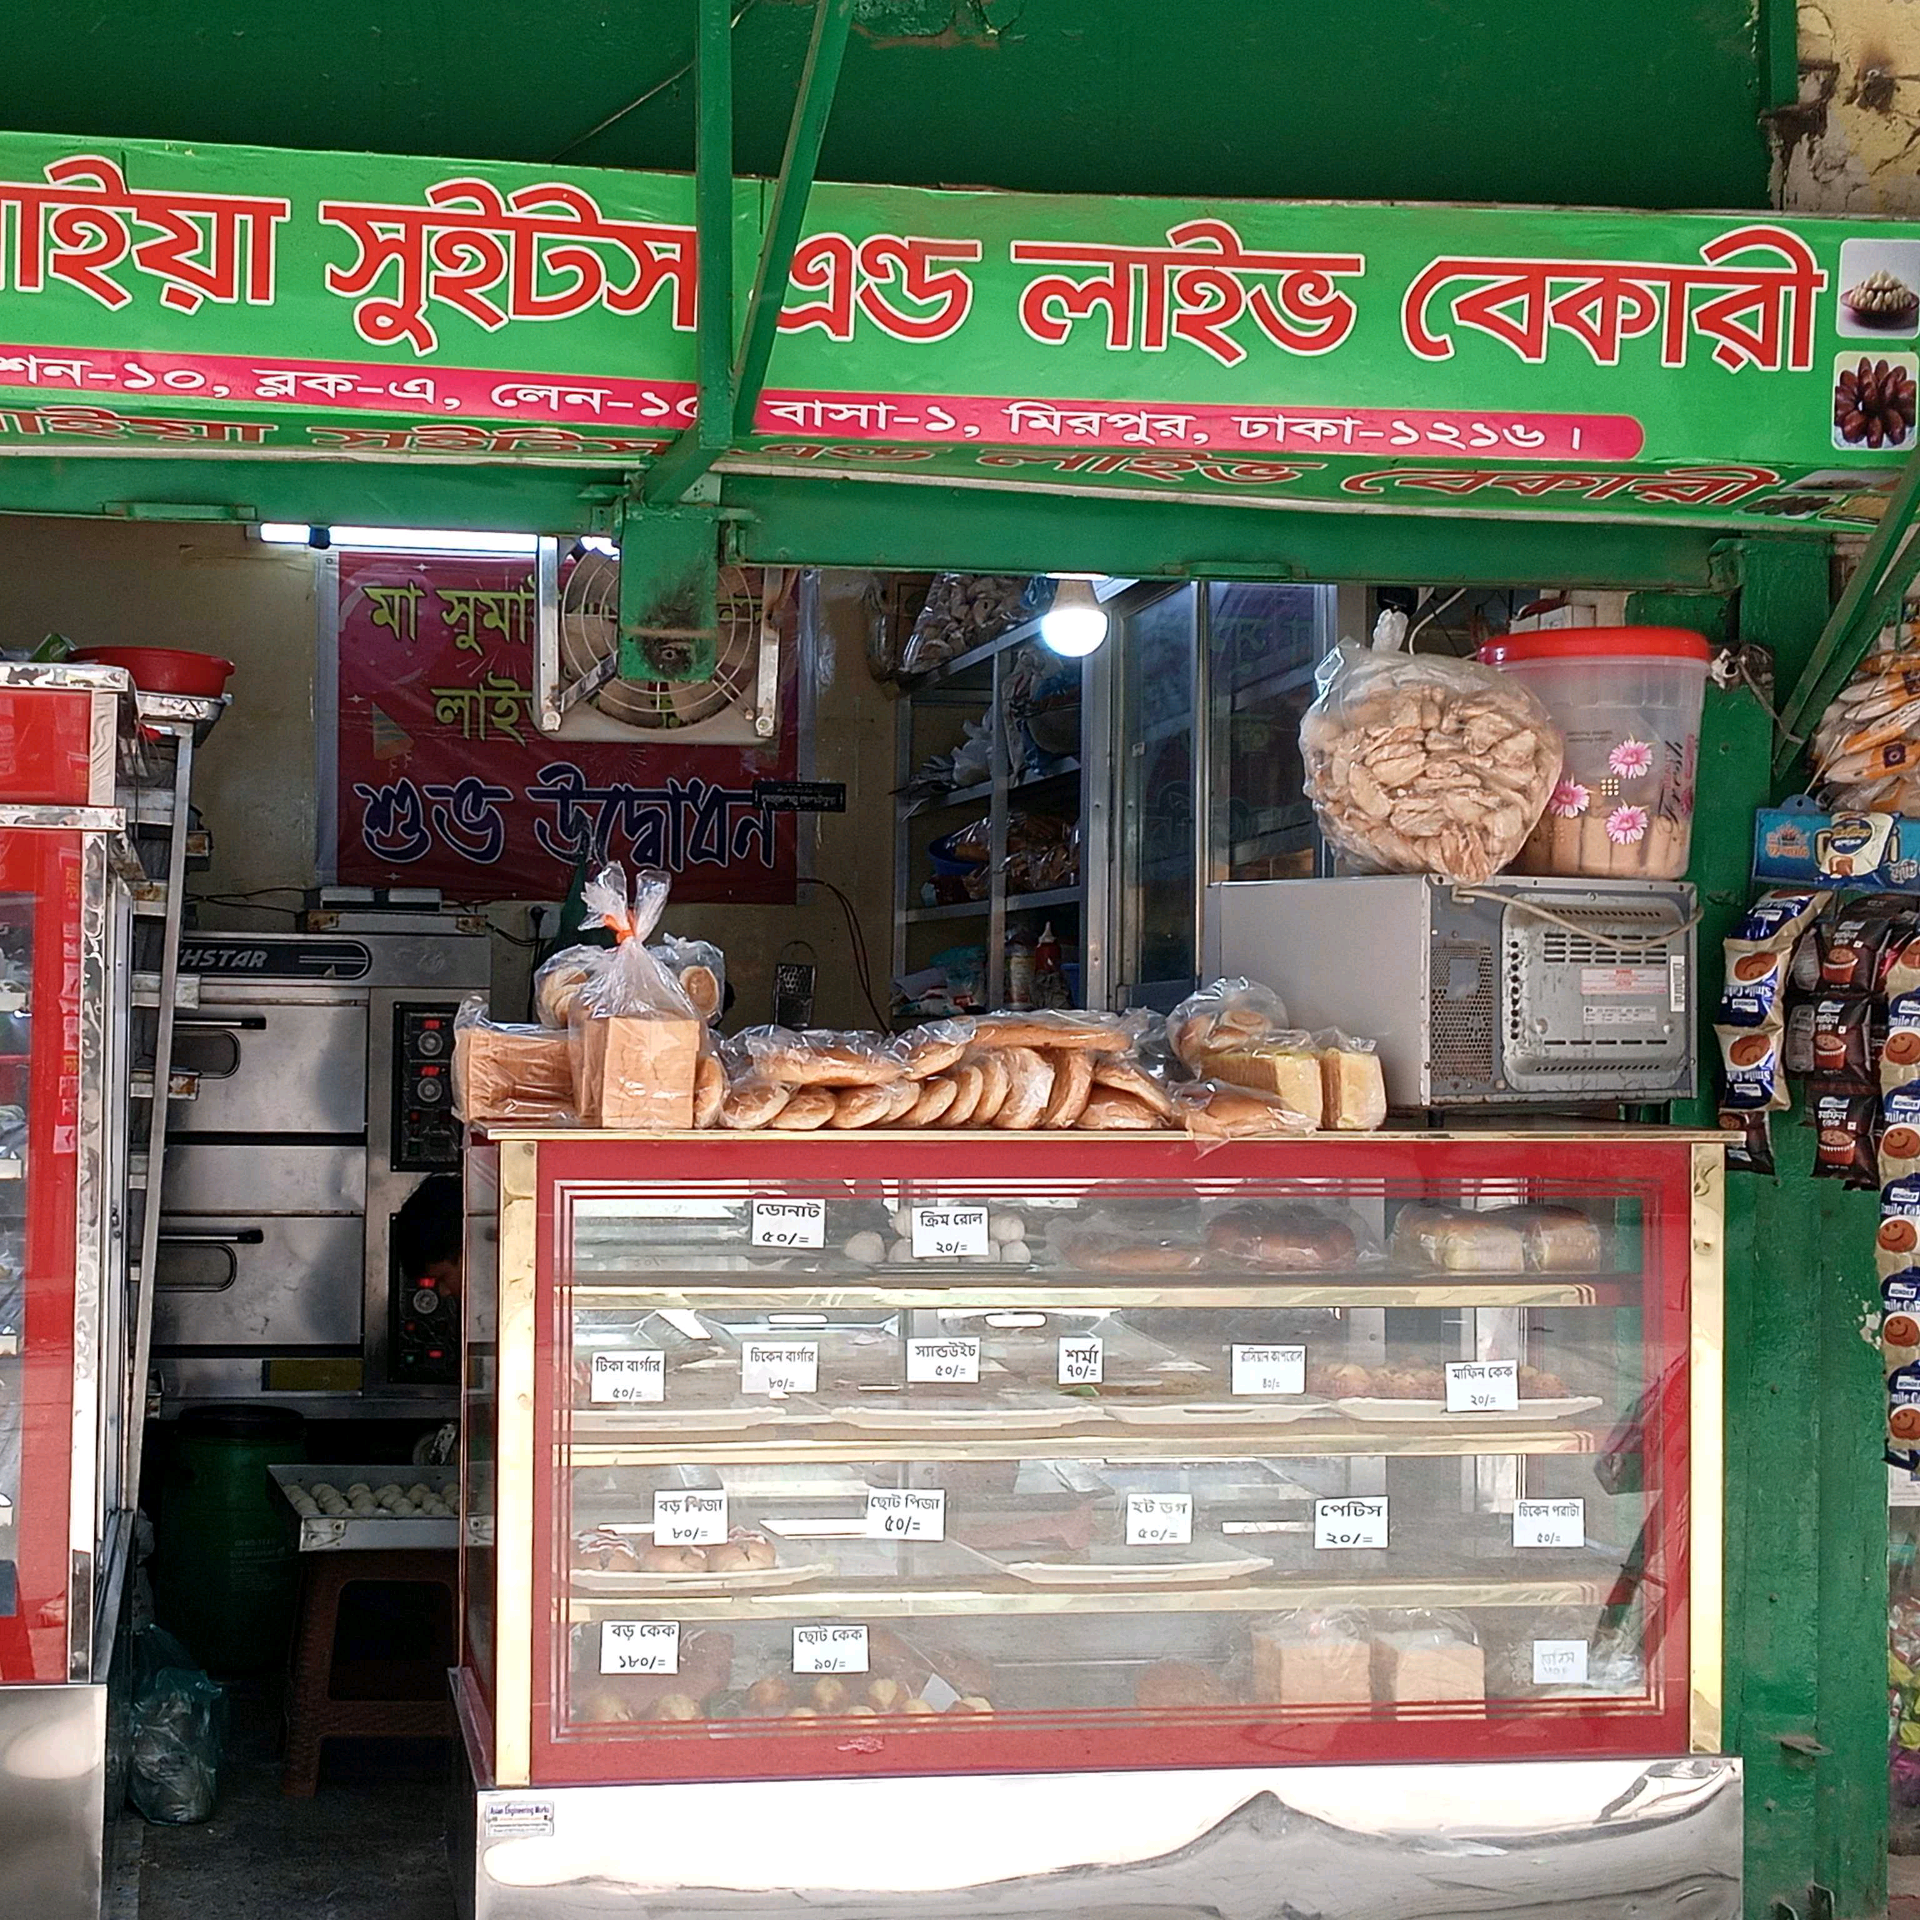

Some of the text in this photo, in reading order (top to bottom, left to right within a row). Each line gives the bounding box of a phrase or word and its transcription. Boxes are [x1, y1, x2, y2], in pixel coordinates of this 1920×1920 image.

[0, 153, 290, 312] াইয়া
[319, 177, 697, 356] সুইটস
[1010, 218, 1366, 367] লাইভ
[1402, 223, 1828, 373] বেকারী
[763, 398, 981, 439] বাসা-১,
[1001, 401, 1210, 446] মিরপুর,
[362, 580, 425, 642] মা
[430, 672, 535, 747] লাই
[354, 776, 514, 865] শুভ
[179, 949, 268, 968] HSTAR
[756, 1202, 821, 1218] ডোনাট
[920, 1211, 983, 1227] ক্রিম রোল
[762, 1230, 809, 1245] ৫০/=
[936, 1241, 968, 1254] ২০/=
[786, 1350, 814, 1363] বার্গার
[1065, 1344, 1099, 1364] শর্মা
[595, 1357, 661, 1373] টিকা বার্গার
[935, 1364, 966, 1377] ৫০/=
[1451, 1365, 1513, 1380] মাফিন কেক
[658, 1495, 723, 1514] বড় পিজা
[870, 1493, 940, 1510] ছোট পিজা
[1132, 1500, 1187, 1515] হট ডগ
[1321, 1501, 1382, 1517] পেটিস
[885, 1515, 920, 1535] ৫০/=
[1326, 1532, 1372, 1545] ২০/=
[611, 1624, 676, 1641] বড় কেক
[798, 1626, 863, 1645] ছোট কেক
[619, 1654, 665, 1669] ১৮০/=
